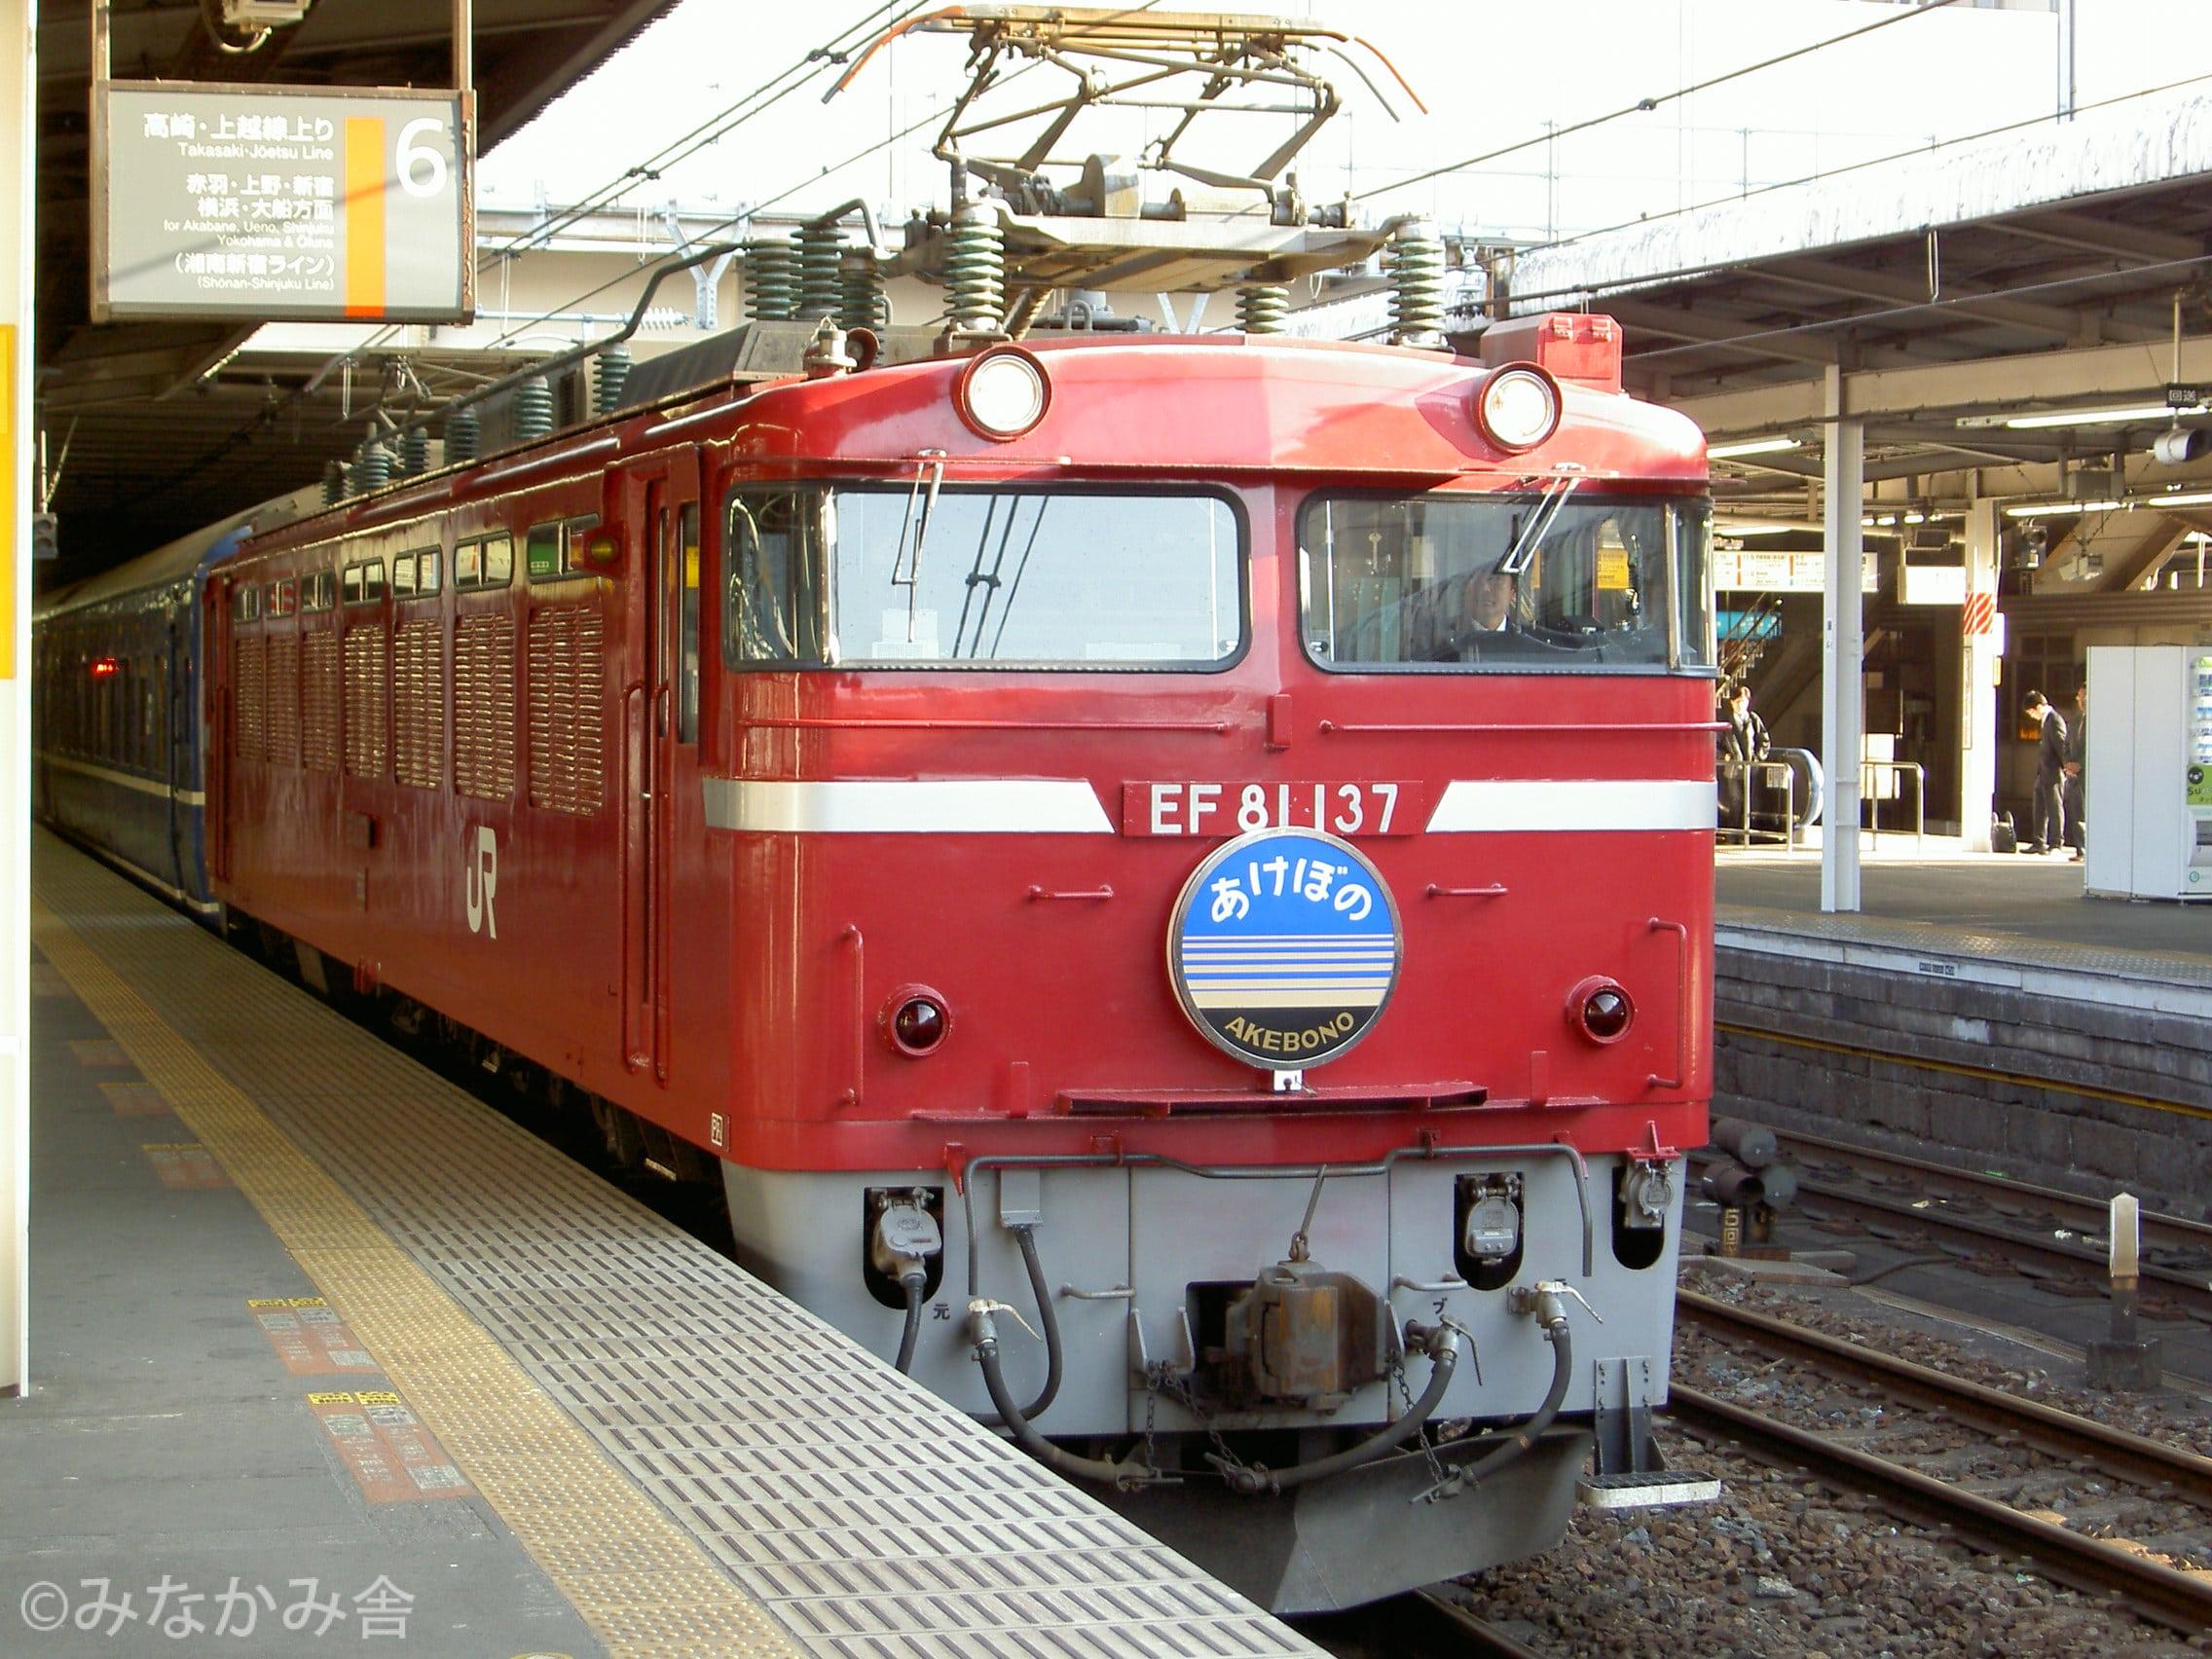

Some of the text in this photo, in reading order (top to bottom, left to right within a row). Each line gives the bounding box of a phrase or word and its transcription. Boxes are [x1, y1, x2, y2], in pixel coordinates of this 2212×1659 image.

[143, 112, 334, 142] 高崎・上越線上り
[302, 143, 334, 161] Line
[395, 116, 448, 198] 6
[186, 172, 334, 198] 赤羽・上野・新宿
[198, 197, 334, 220] 横浜・大船方面
[163, 219, 180, 232] for
[217, 235, 281, 248] Yokohama
[283, 236, 294, 248] &
[305, 277, 335, 291] Line)
[1314, 784, 1399, 833] 137
[466, 825, 498, 940] JR
[1210, 855, 1373, 923] あけぼの
[1224, 1011, 1355, 1052] AKEBONO
[933, 1302, 950, 1320] 元
